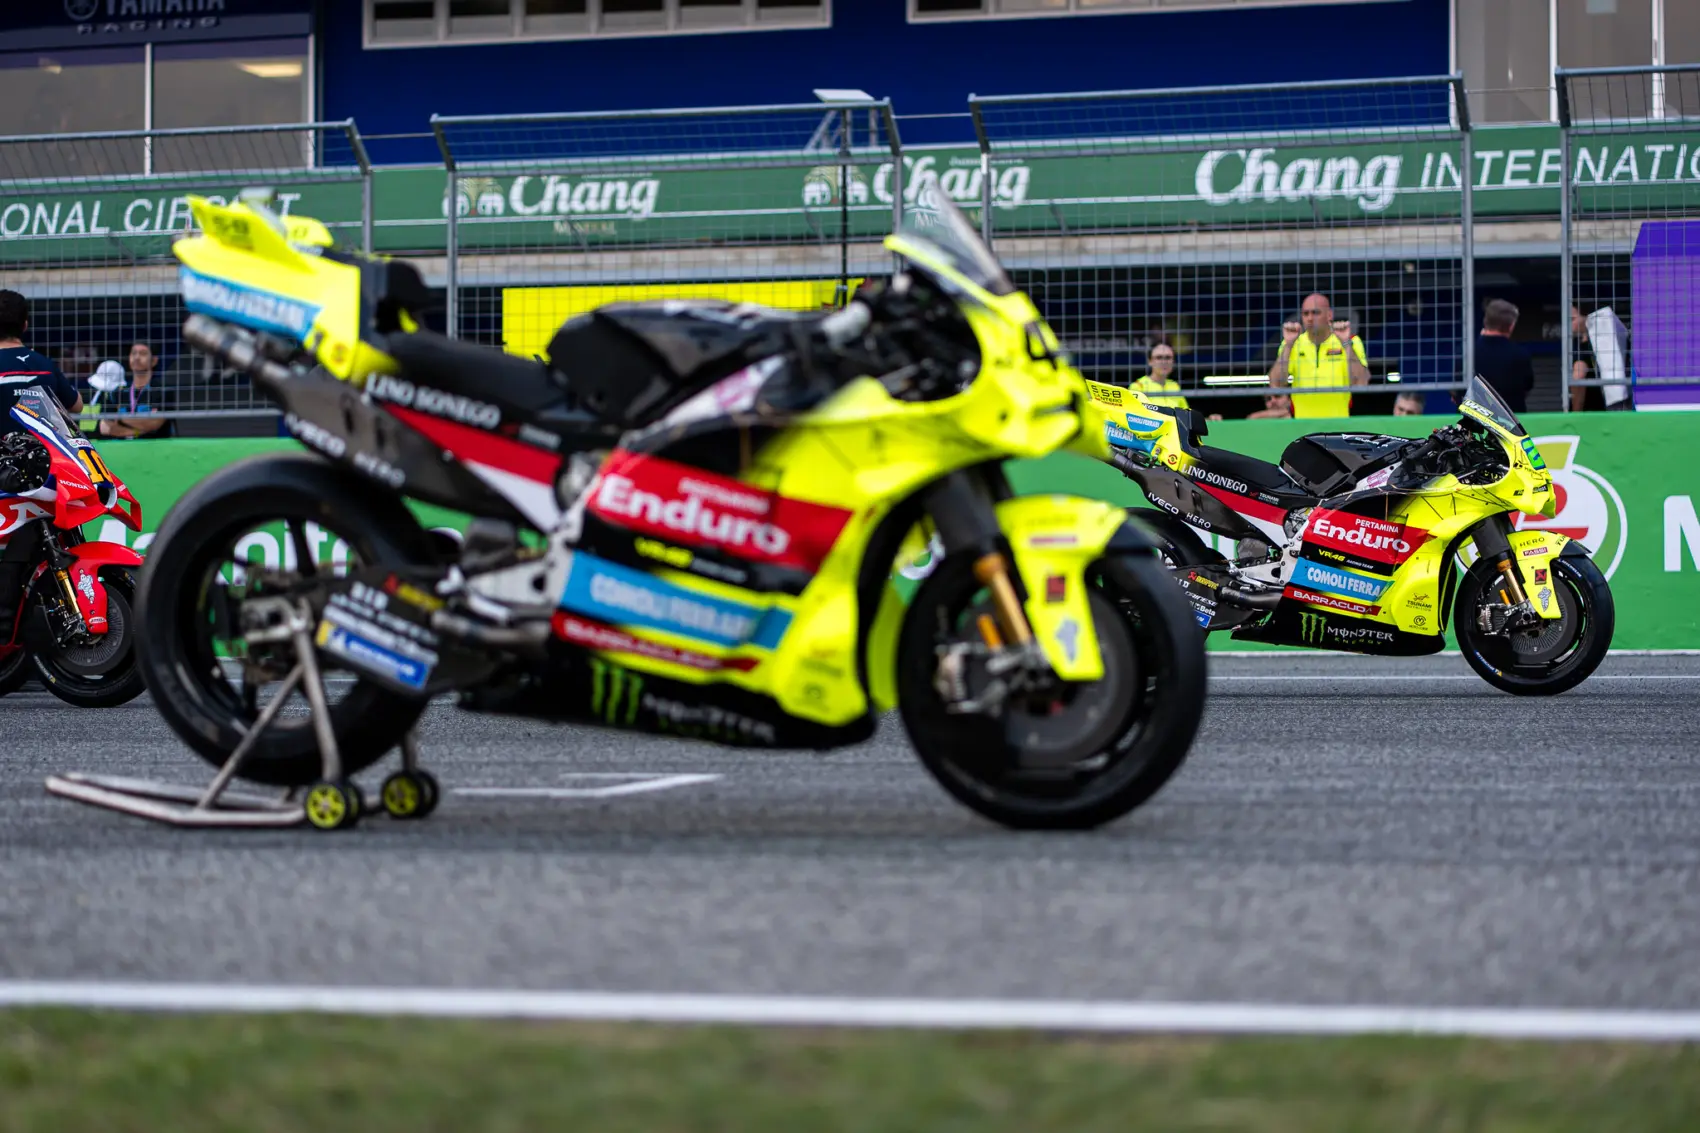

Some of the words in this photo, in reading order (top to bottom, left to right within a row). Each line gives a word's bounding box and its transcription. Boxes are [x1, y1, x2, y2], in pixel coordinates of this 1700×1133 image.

[77, 16, 221, 35] RACING
[872, 155, 1030, 210] Chang
[1195, 147, 1403, 210] Chang
[1420, 143, 1700, 191] INTERNATI
[0, 200, 110, 236] ONAL
[123, 192, 301, 232] CIRT
[508, 175, 660, 220] Chang
[77, 449, 114, 483] 10
[1181, 463, 1207, 480] LINO
[1206, 472, 1248, 493] SONEGO
[598, 473, 791, 556] Enduro
[1148, 492, 1179, 515] IVECO
[1186, 512, 1212, 529] HERO
[1355, 518, 1399, 534] PERTAMINA
[1313, 518, 1411, 553] Enduro
[1519, 536, 1545, 547] HERO
[1307, 566, 1347, 589] COMOLI
[1347, 577, 1387, 600] FERRA
